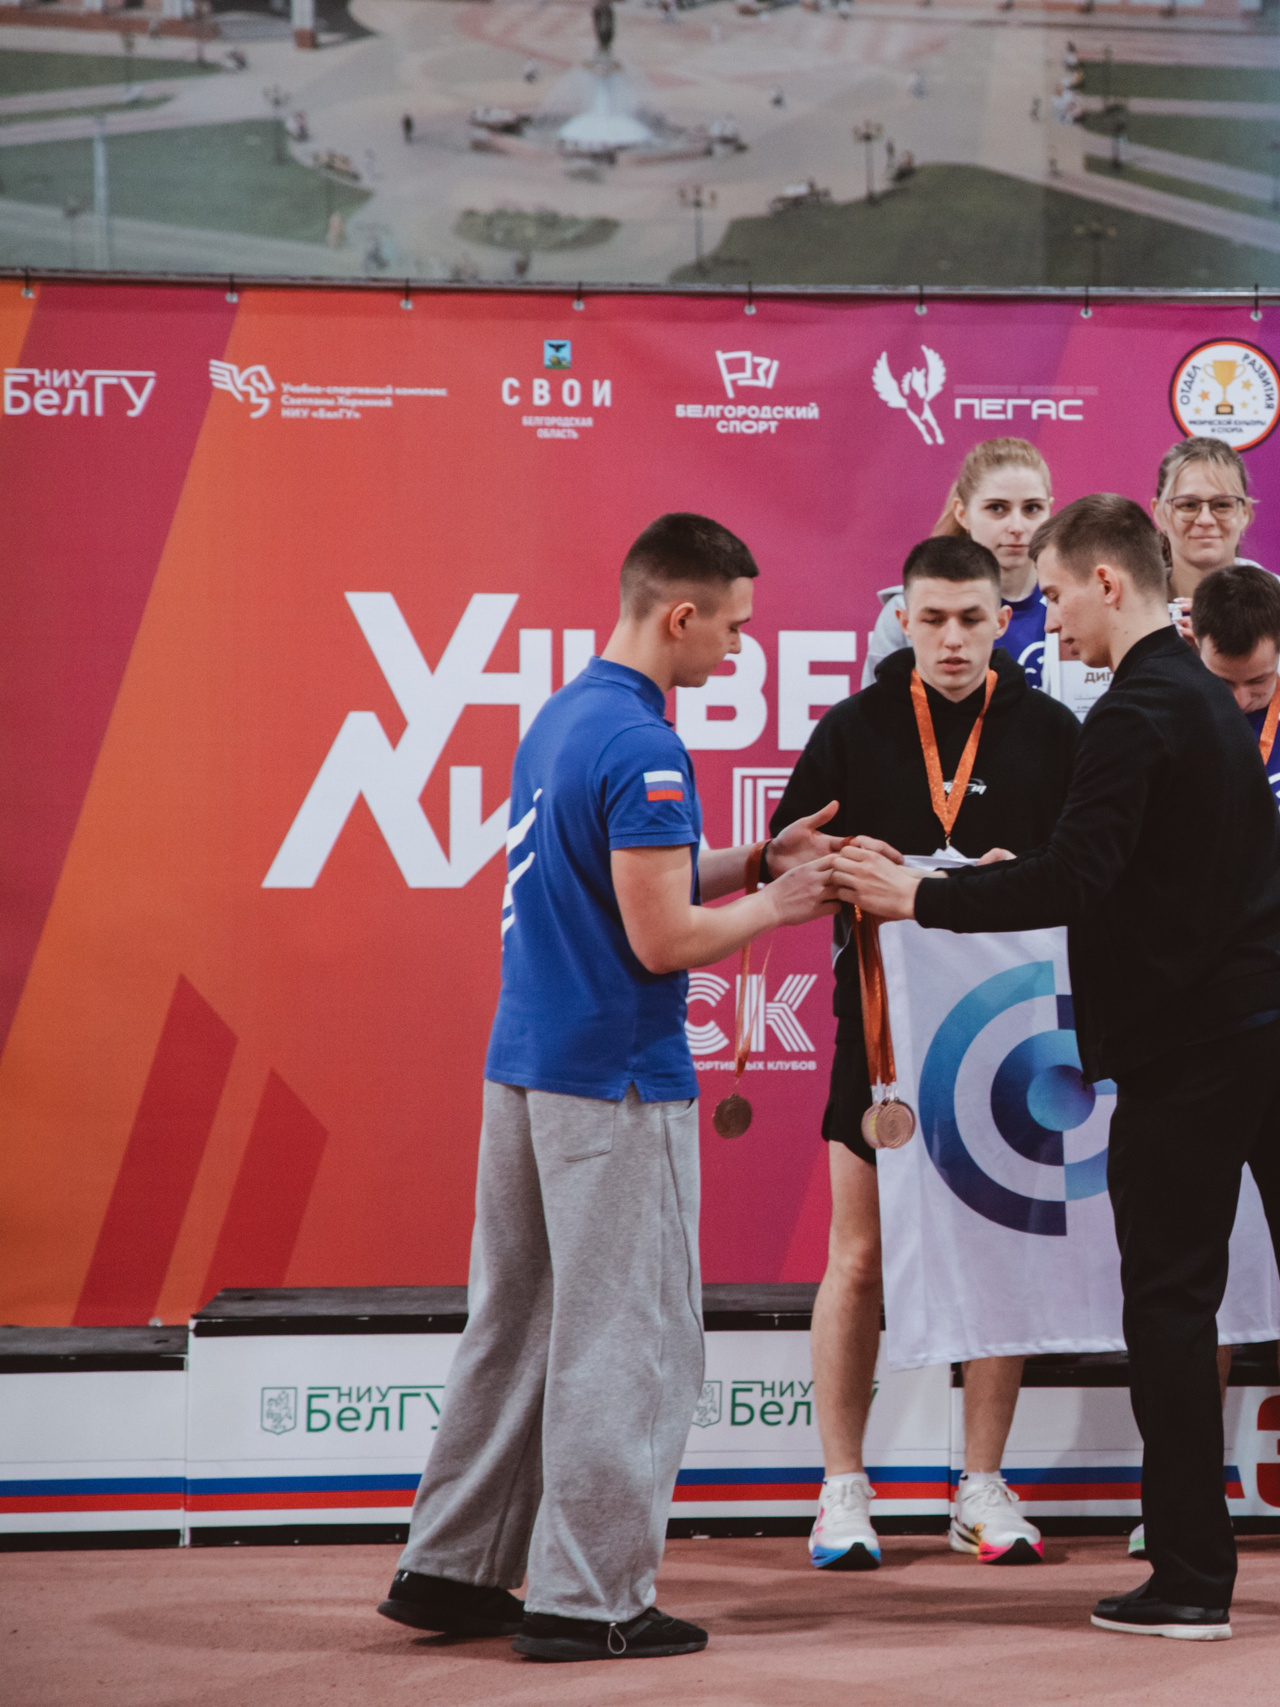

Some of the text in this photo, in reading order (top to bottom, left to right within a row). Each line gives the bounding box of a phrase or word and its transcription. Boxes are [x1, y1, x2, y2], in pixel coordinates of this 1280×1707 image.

[34, 368, 87, 388] НИУ
[1180, 365, 1201, 405] ОТДЕЛ
[1242, 353, 1275, 409] РАЗВИТИЯ
[4, 375, 156, 417] БелГУ
[501, 377, 612, 407] СВОИ
[675, 402, 819, 419] БЕЛГОРОДСКИЙ
[954, 398, 1083, 421] ПЕГАС
[521, 415, 593, 427] БЕЛГОРОДСКАЯ
[716, 419, 778, 434] СПОРТ
[536, 428, 579, 439] ОБЛАСТЬ
[692, 1060, 817, 1071] ОРТИВЫХ КЛУБОВ
[338, 1386, 391, 1403] НИУ
[761, 1381, 814, 1398] НИУ
